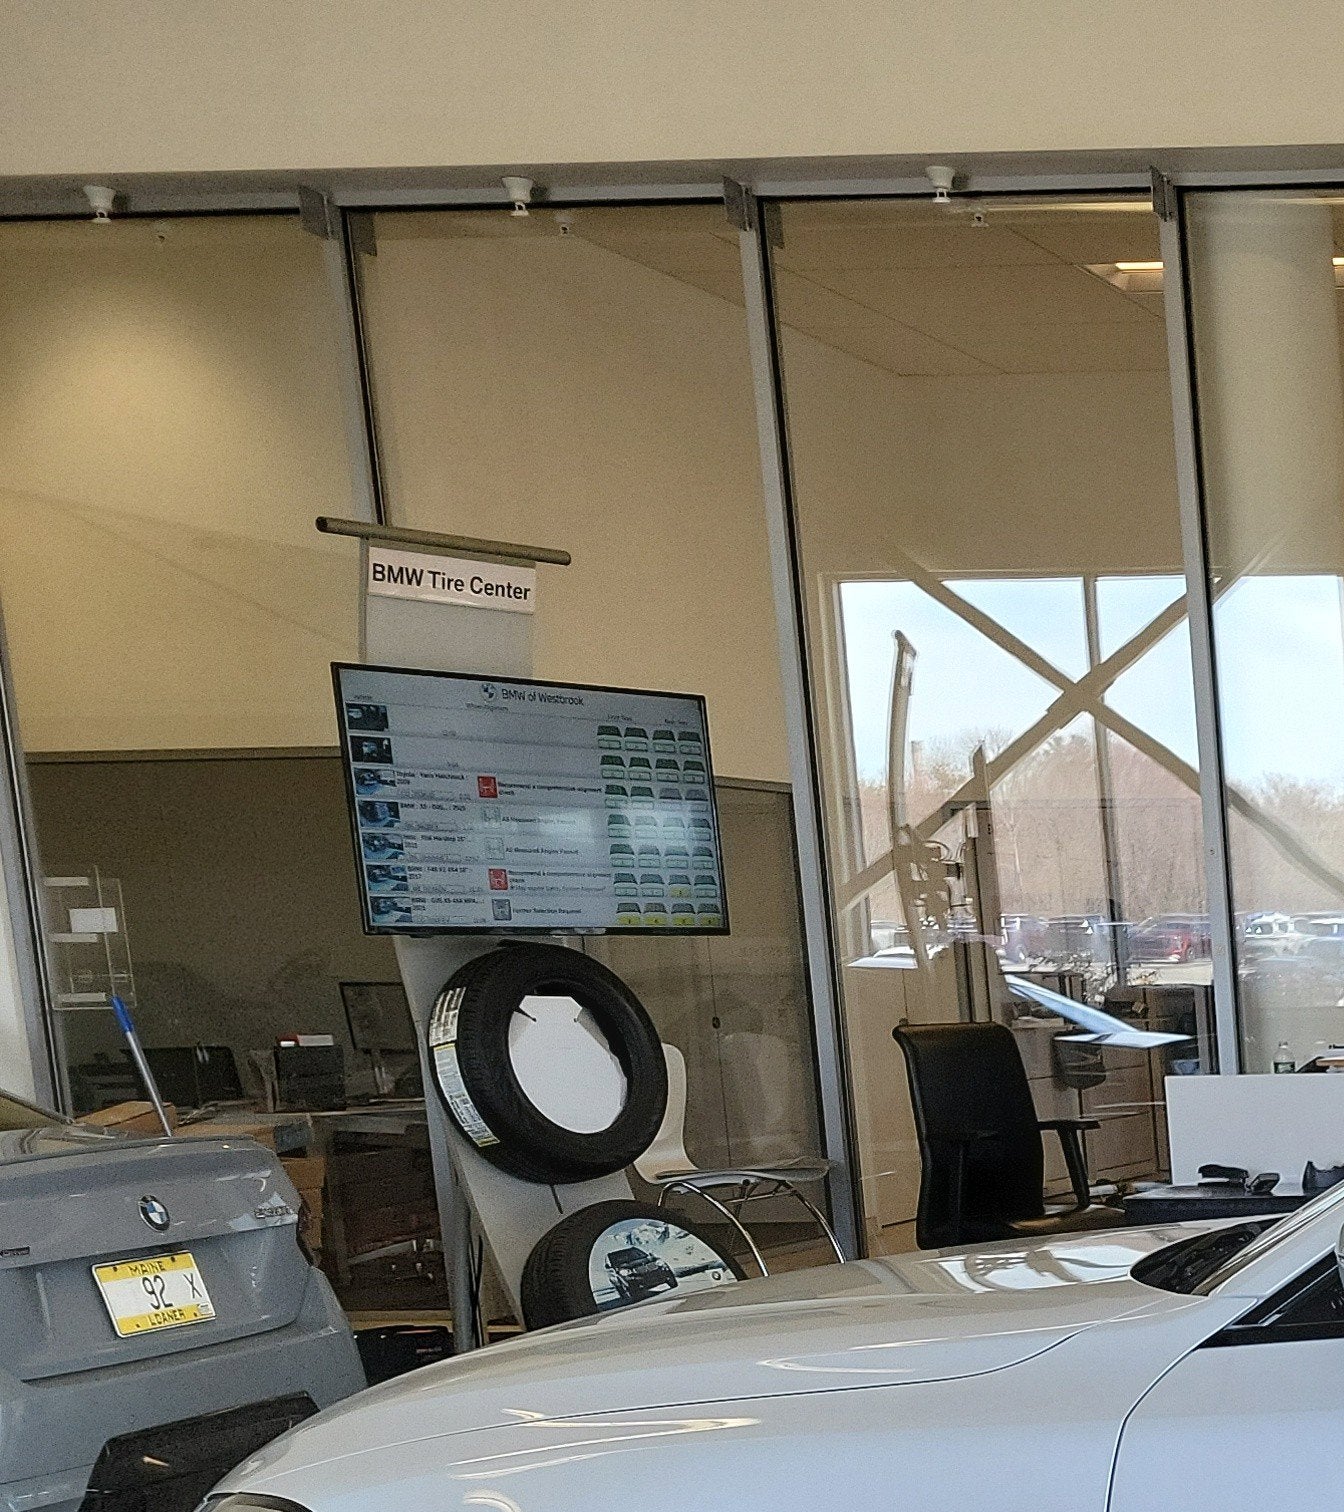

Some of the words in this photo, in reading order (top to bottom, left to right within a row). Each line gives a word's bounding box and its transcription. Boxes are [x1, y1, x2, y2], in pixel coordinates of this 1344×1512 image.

[372, 562, 424, 587] BMW
[427, 569, 465, 592] Tire
[470, 576, 531, 600] Center
[501, 688, 526, 700] BMW
[128, 1260, 166, 1276] MAINE
[142, 1274, 174, 1310] 92
[182, 1272, 203, 1299] X
[147, 1308, 187, 1326] LOANER
